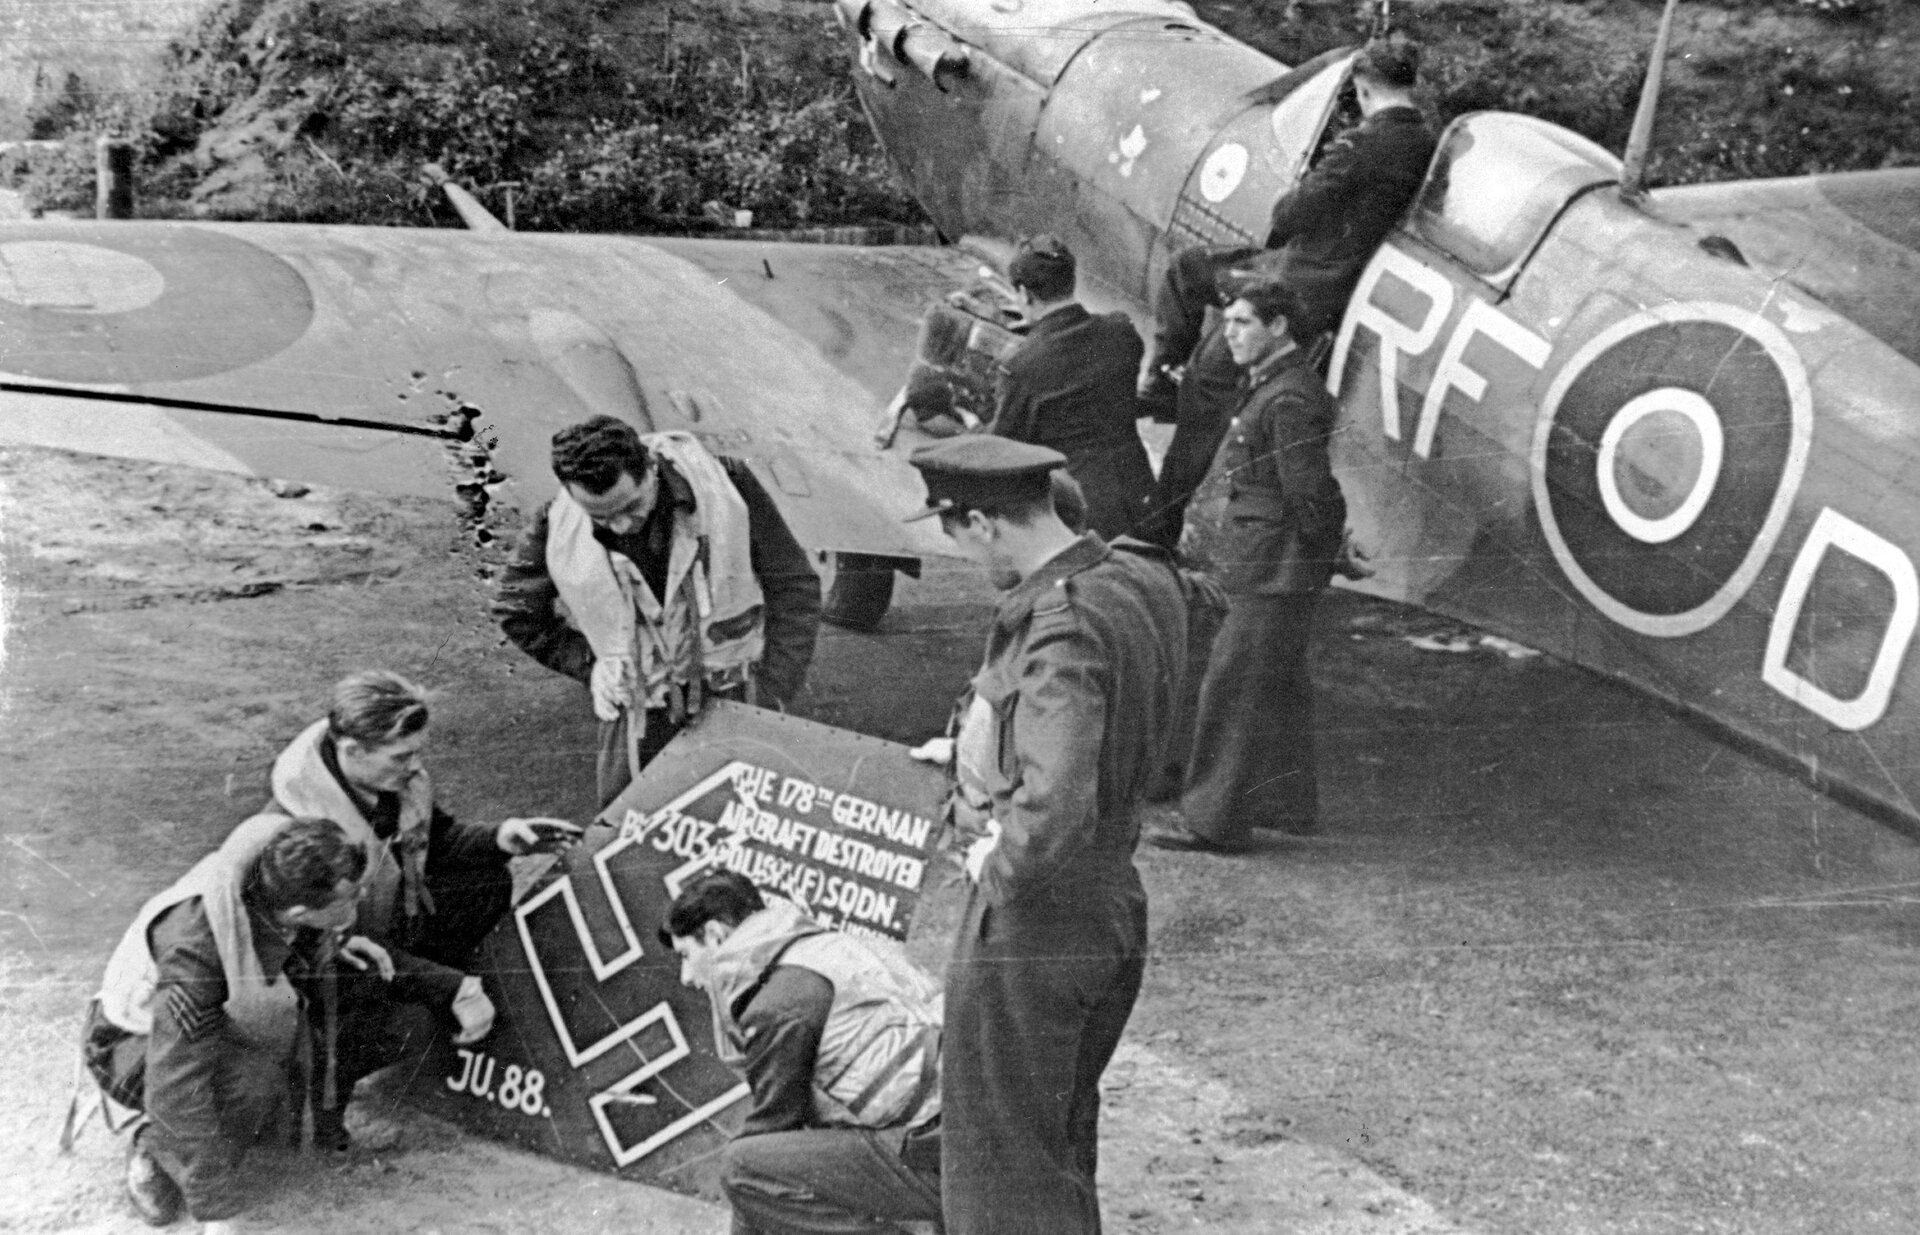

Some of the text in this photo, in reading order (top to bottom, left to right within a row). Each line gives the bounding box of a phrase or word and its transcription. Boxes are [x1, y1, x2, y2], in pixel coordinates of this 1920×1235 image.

[1326, 242, 1919, 731] RF D
[717, 799, 927, 890] AIRCRAFT DESTROYED
[733, 763, 778, 802] THE
[832, 793, 931, 850] GERMAN
[620, 808, 653, 845] BY
[651, 808, 716, 861] 303
[822, 876, 902, 931] SQDN.
